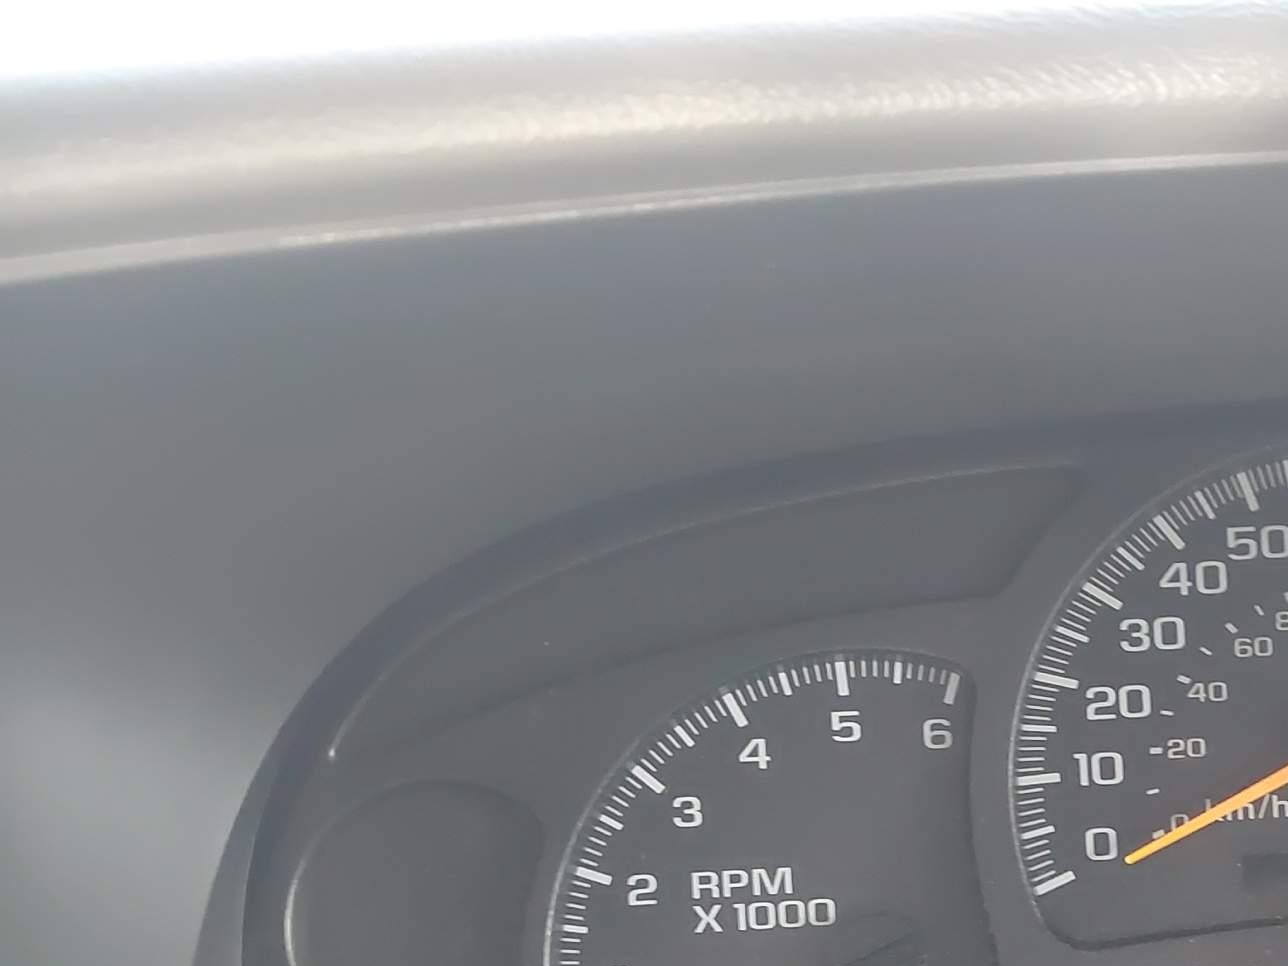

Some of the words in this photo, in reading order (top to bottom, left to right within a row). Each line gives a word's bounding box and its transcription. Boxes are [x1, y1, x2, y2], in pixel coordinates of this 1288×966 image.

[1159, 561, 1228, 596] 40
[1119, 617, 1185, 652] 30
[1234, 637, 1273, 657] 60
[1086, 685, 1151, 720] 20
[1188, 682, 1228, 702] 40
[831, 711, 861, 742] 5
[923, 719, 952, 749] 6
[739, 739, 771, 769] 4
[1168, 738, 1206, 758] 20
[1073, 752, 1124, 785] 10
[673, 797, 703, 828] 3
[1085, 828, 1118, 861] 0
[628, 875, 657, 906] 2
[691, 868, 793, 899] RPM
